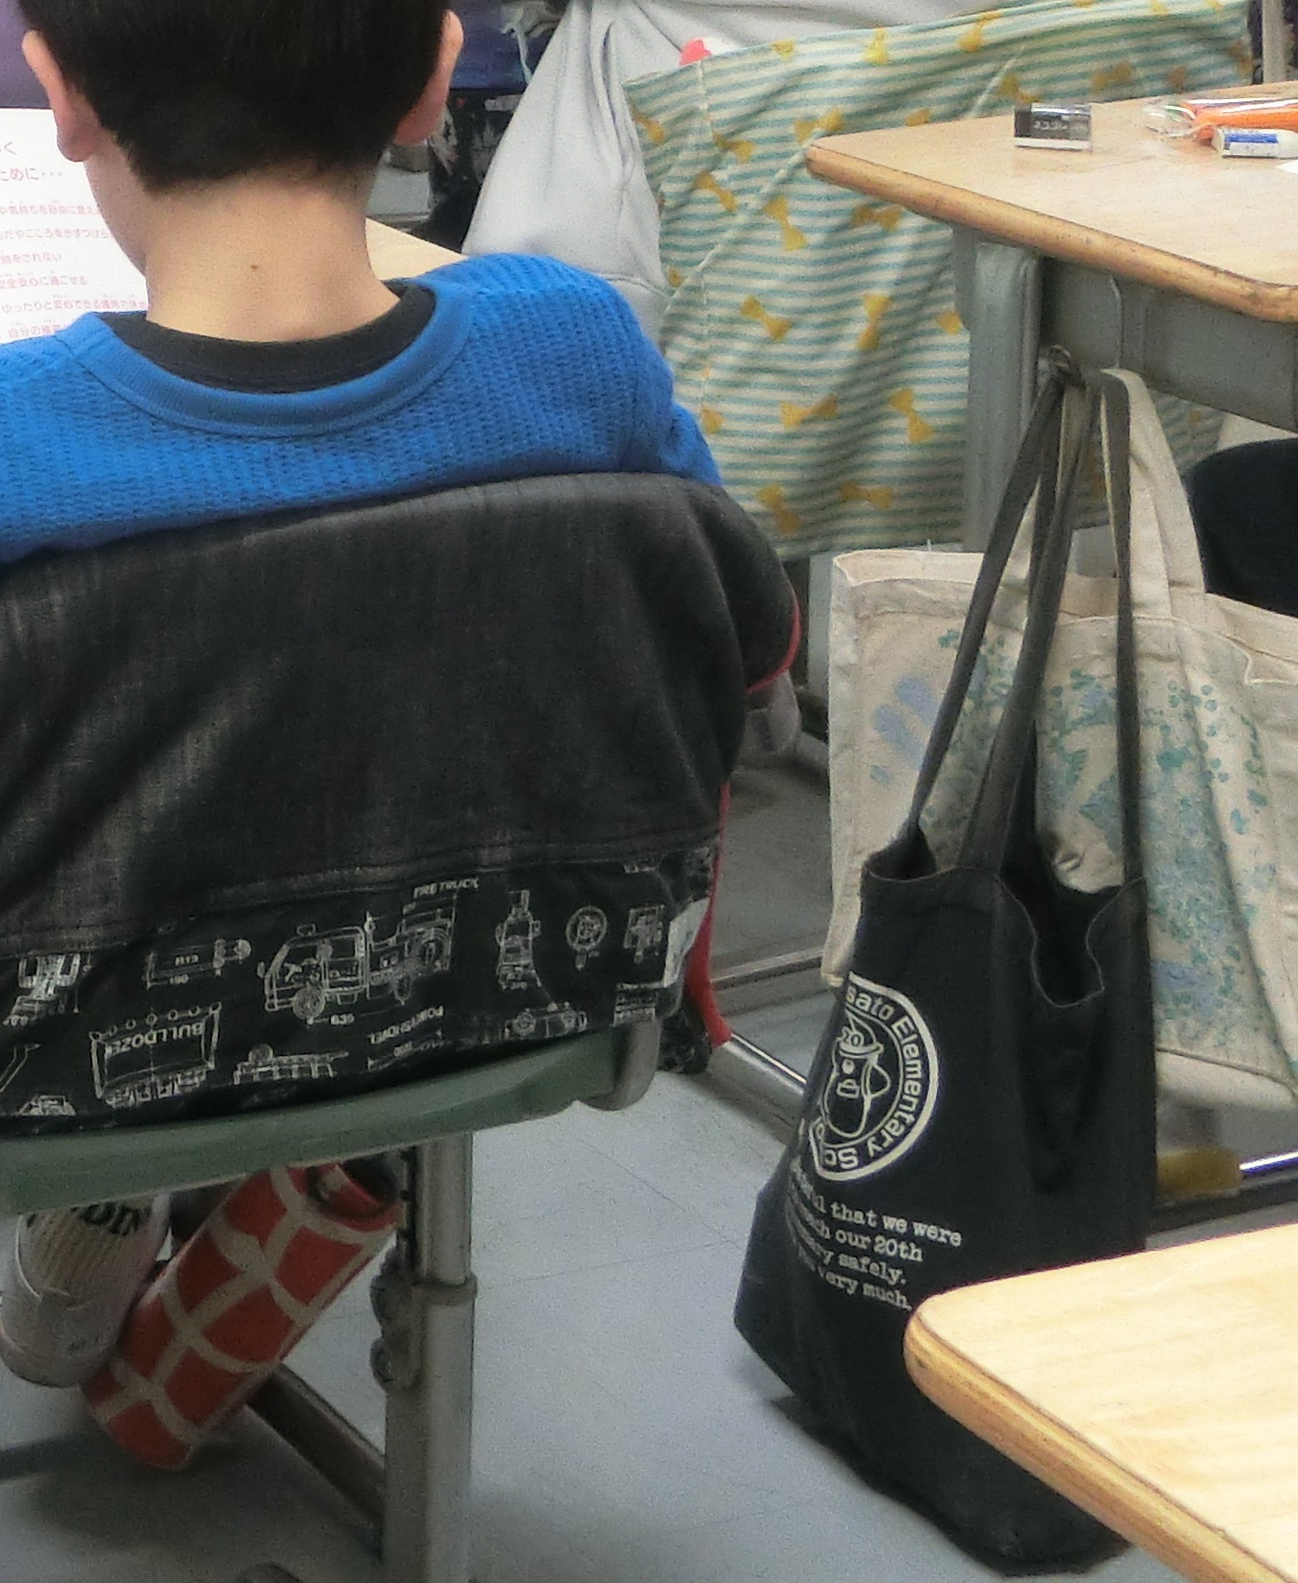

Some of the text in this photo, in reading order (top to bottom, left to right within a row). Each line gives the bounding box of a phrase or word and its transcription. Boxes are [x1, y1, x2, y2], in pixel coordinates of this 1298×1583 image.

[866, 1018, 923, 1158] Elementary
[830, 1201, 878, 1228] that
[882, 1215, 908, 1235] we
[912, 1221, 963, 1248] were
[835, 1228, 924, 1263] our 20th
[838, 1252, 907, 1287] safely.
[862, 1282, 913, 1312] much.
